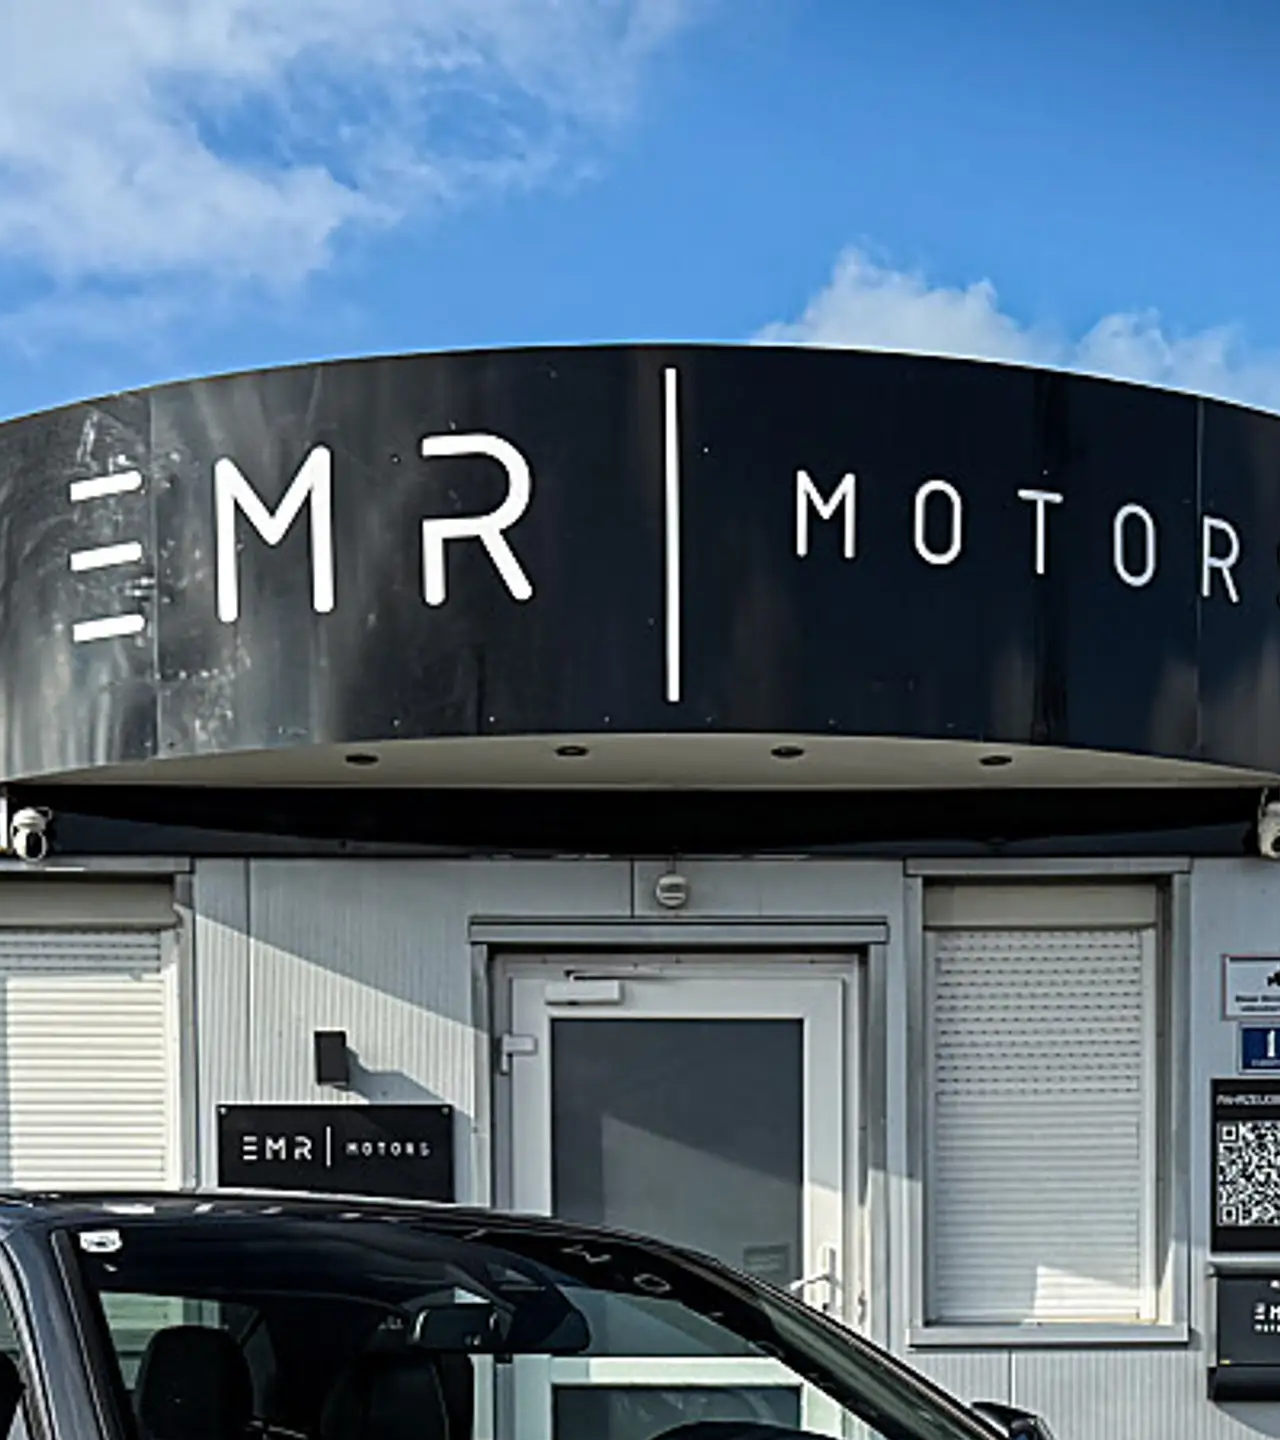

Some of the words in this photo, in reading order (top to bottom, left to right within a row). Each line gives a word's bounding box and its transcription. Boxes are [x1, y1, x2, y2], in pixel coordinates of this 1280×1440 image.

[70, 430, 533, 643] EMR
[242, 1135, 313, 1161] EMR
[345, 1141, 432, 1157] MOTORS
